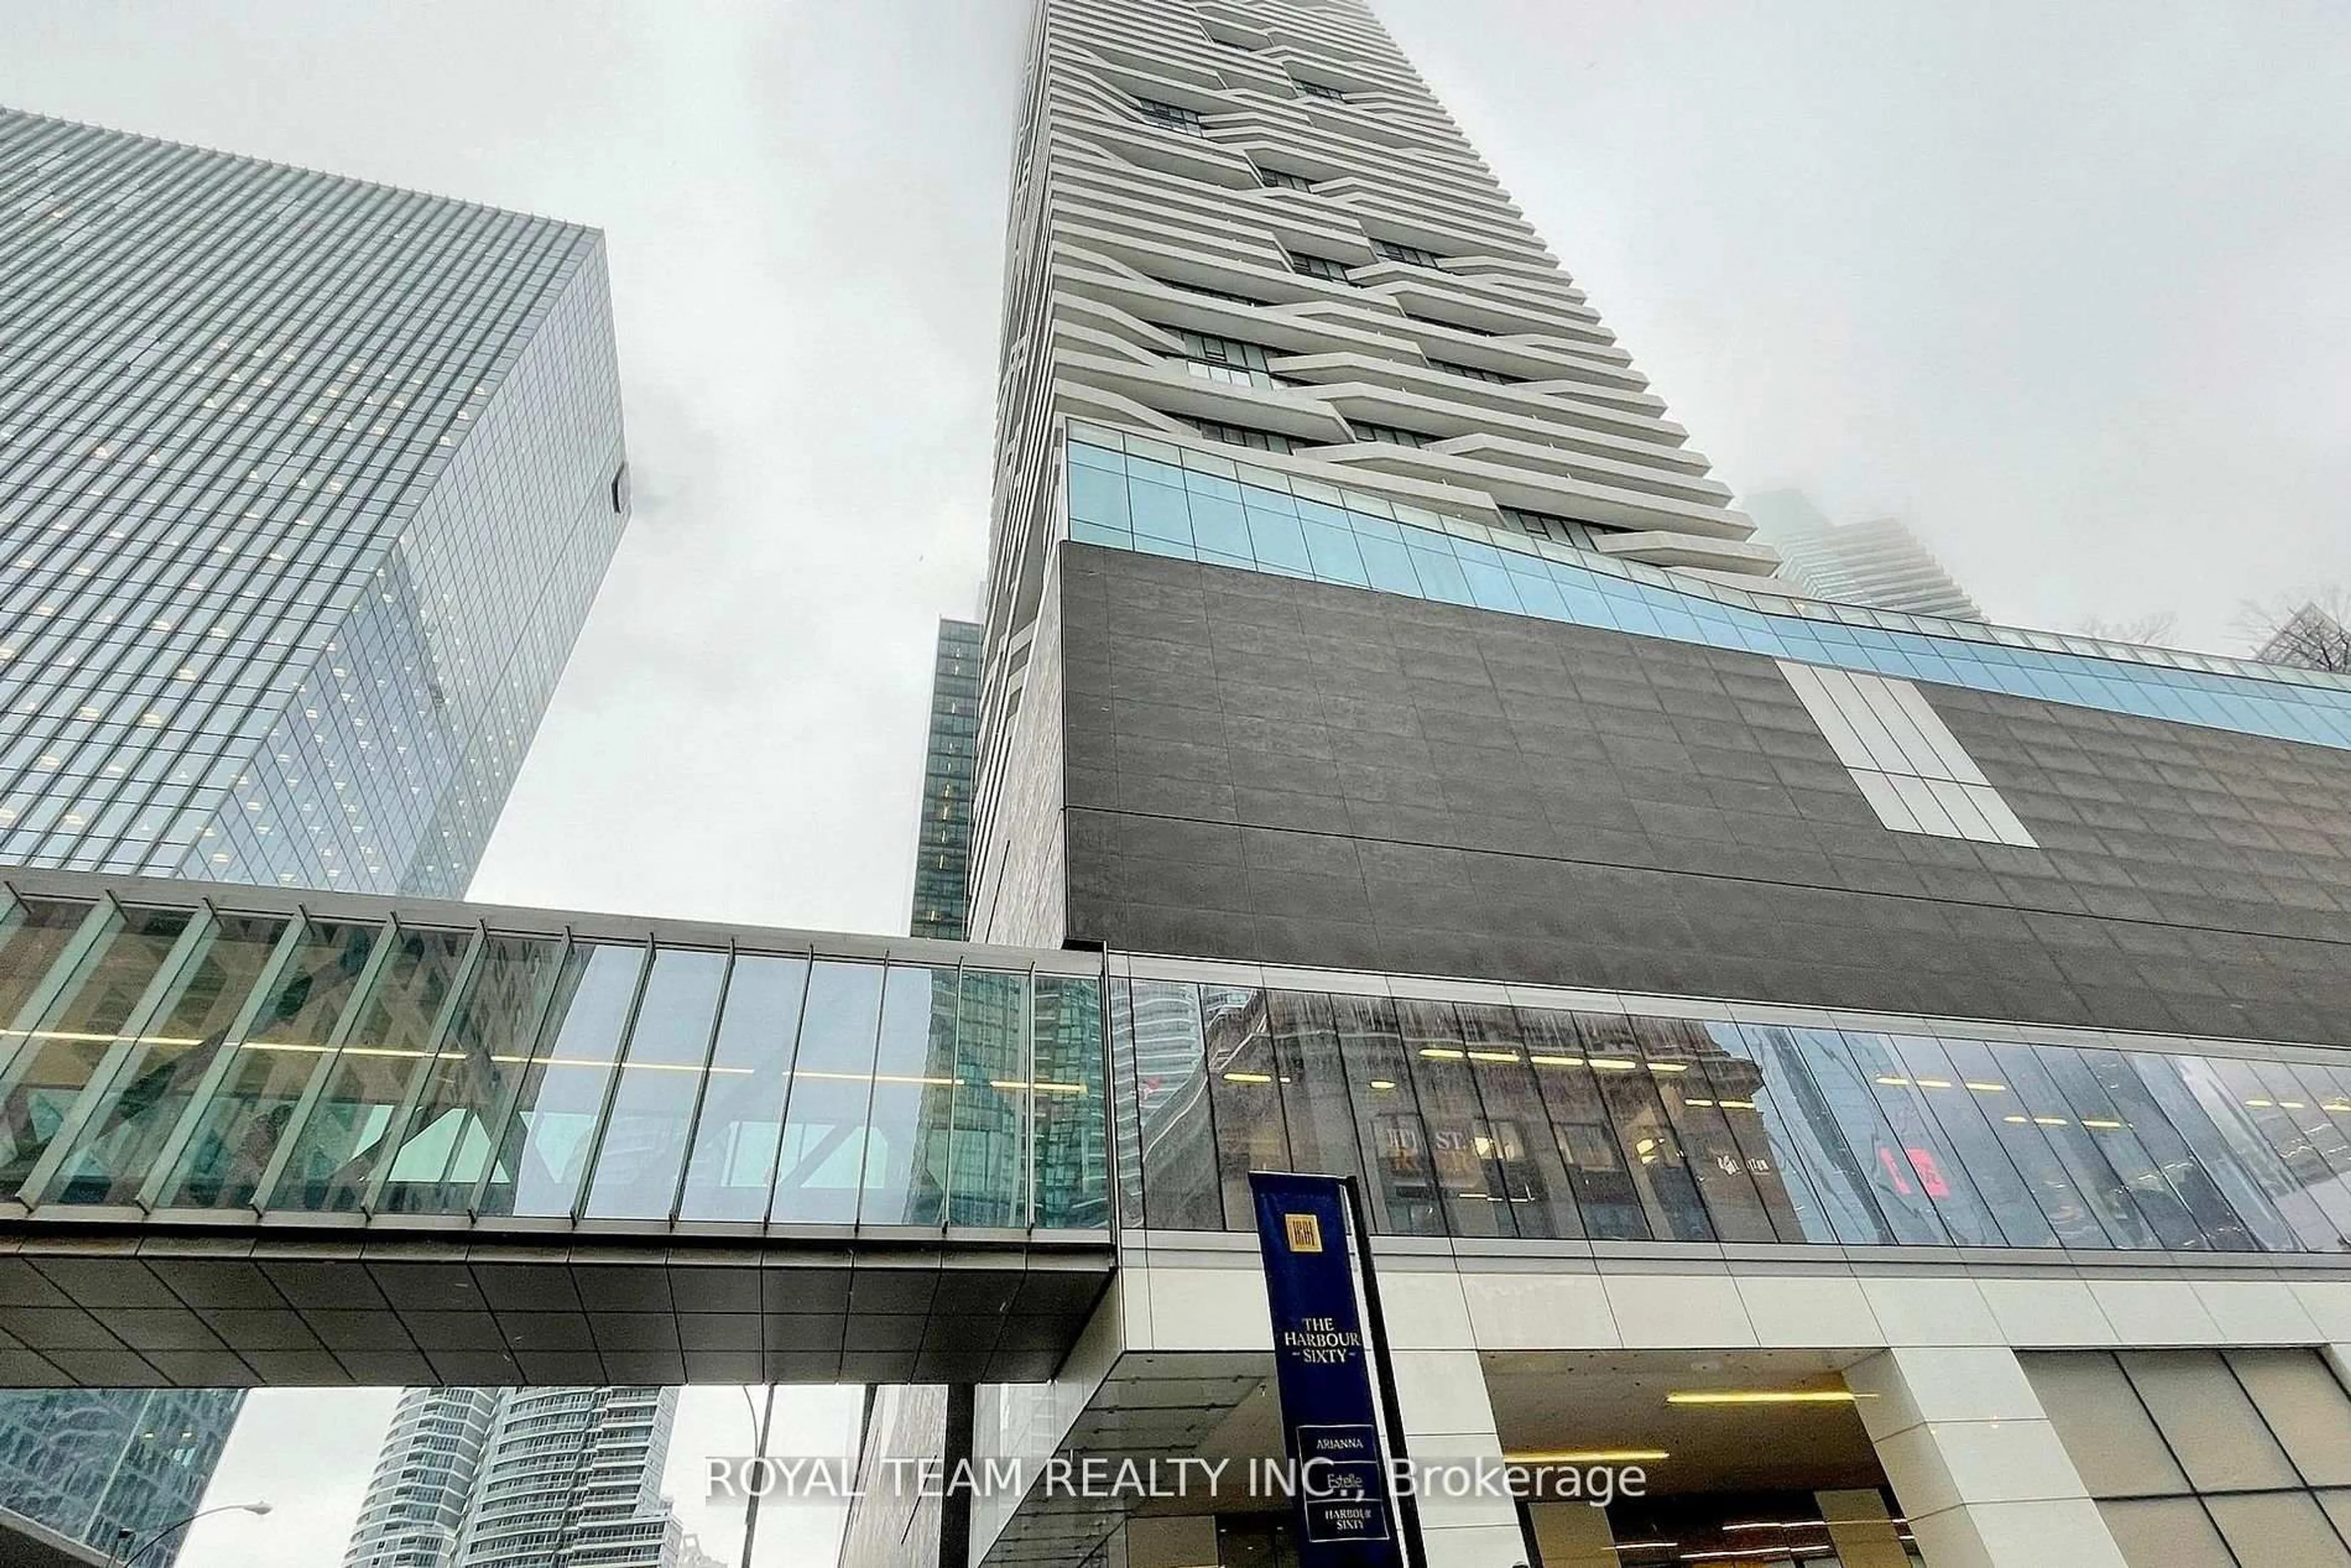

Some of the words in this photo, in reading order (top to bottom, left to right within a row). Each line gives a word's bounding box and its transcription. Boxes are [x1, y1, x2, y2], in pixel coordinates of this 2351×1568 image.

[1302, 1318, 1334, 1331] THE
[1285, 1332, 1361, 1347] HARBOUR
[1317, 1439, 1363, 1449] ARIANNA
[1325, 1509, 1371, 1520] HARBOUR
[1337, 1520, 1364, 1530] SIXTY
